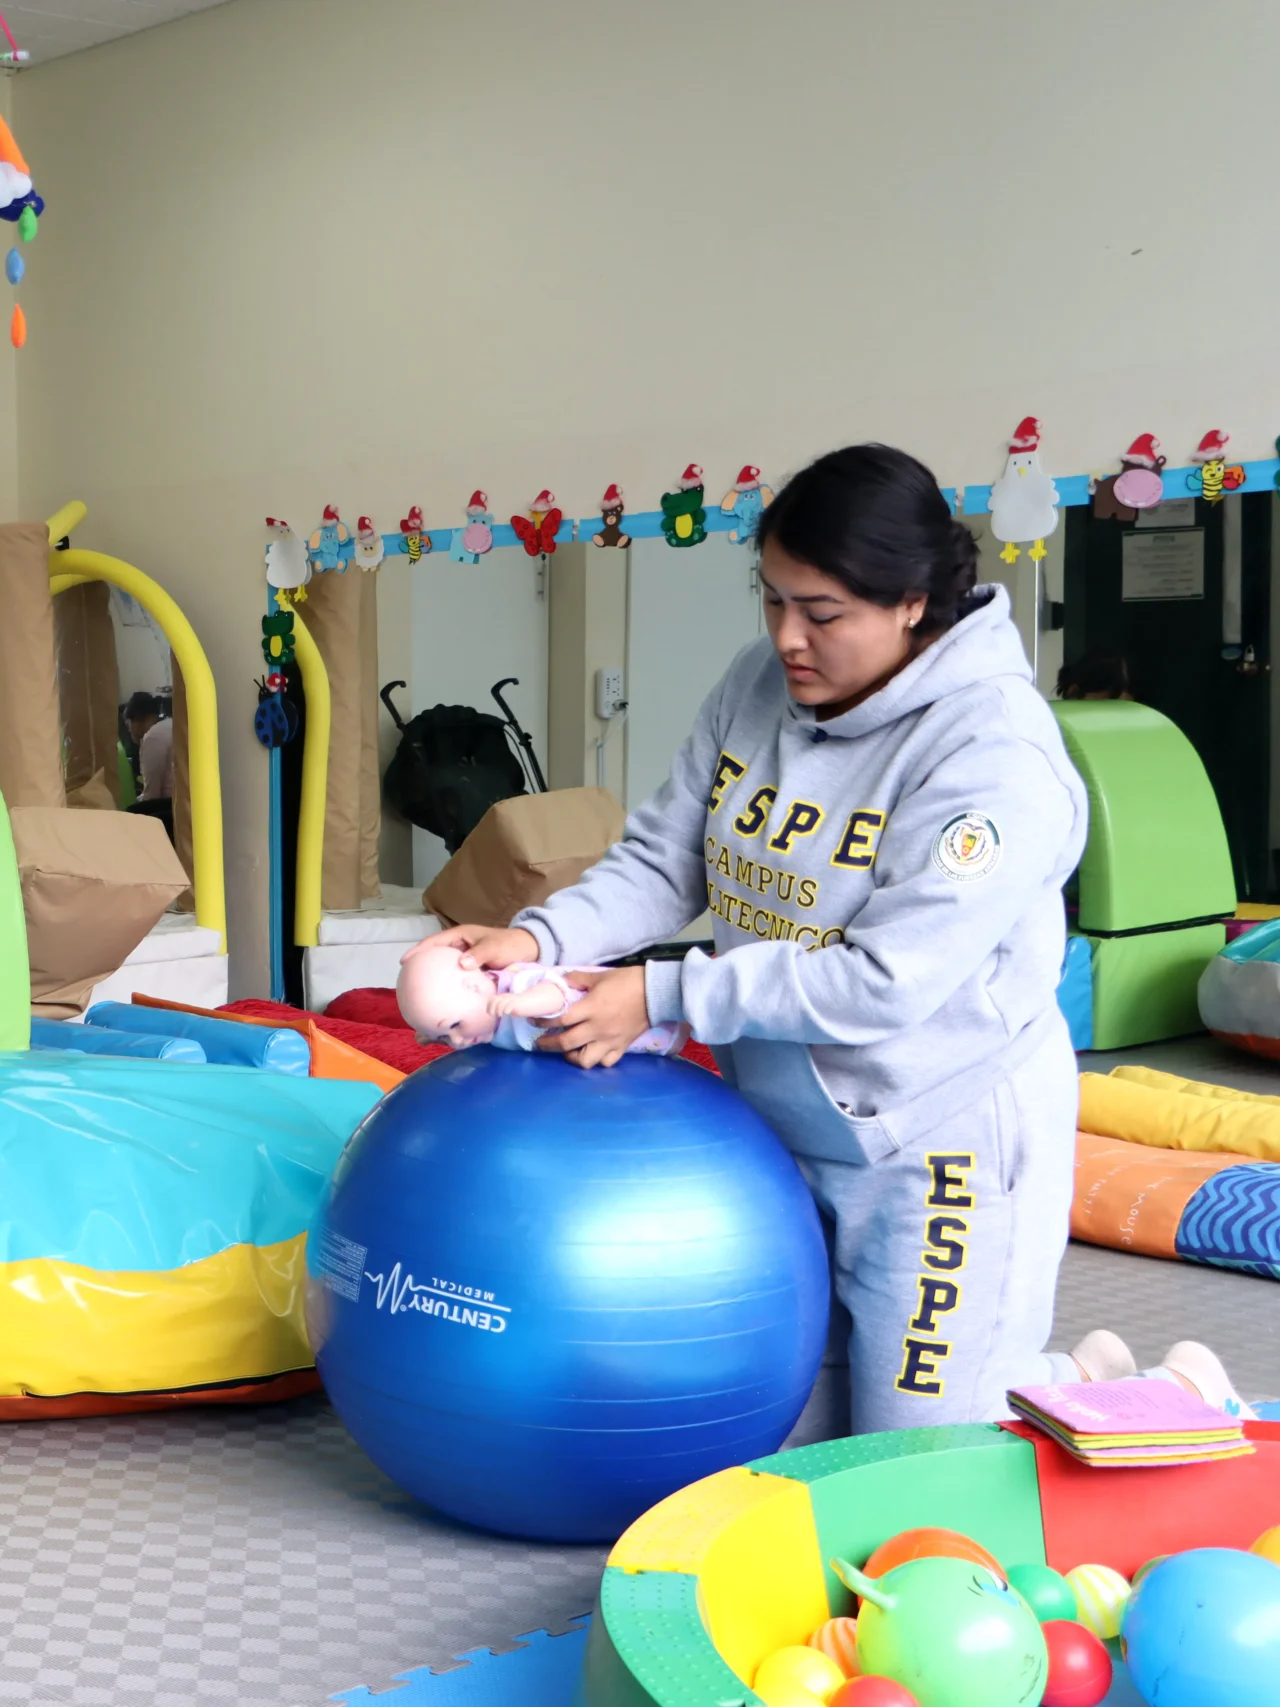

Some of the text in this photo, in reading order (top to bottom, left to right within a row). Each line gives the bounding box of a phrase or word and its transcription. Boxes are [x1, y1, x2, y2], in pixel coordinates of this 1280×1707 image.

[708, 751, 886, 870] ESPE
[704, 836, 818, 909] CAMPUS
[706, 882, 845, 953] LITECNICO
[431, 1277, 495, 1302] MEDICAL
[894, 1152, 976, 1398] ESPE
[407, 1293, 507, 1333] CENTURY
